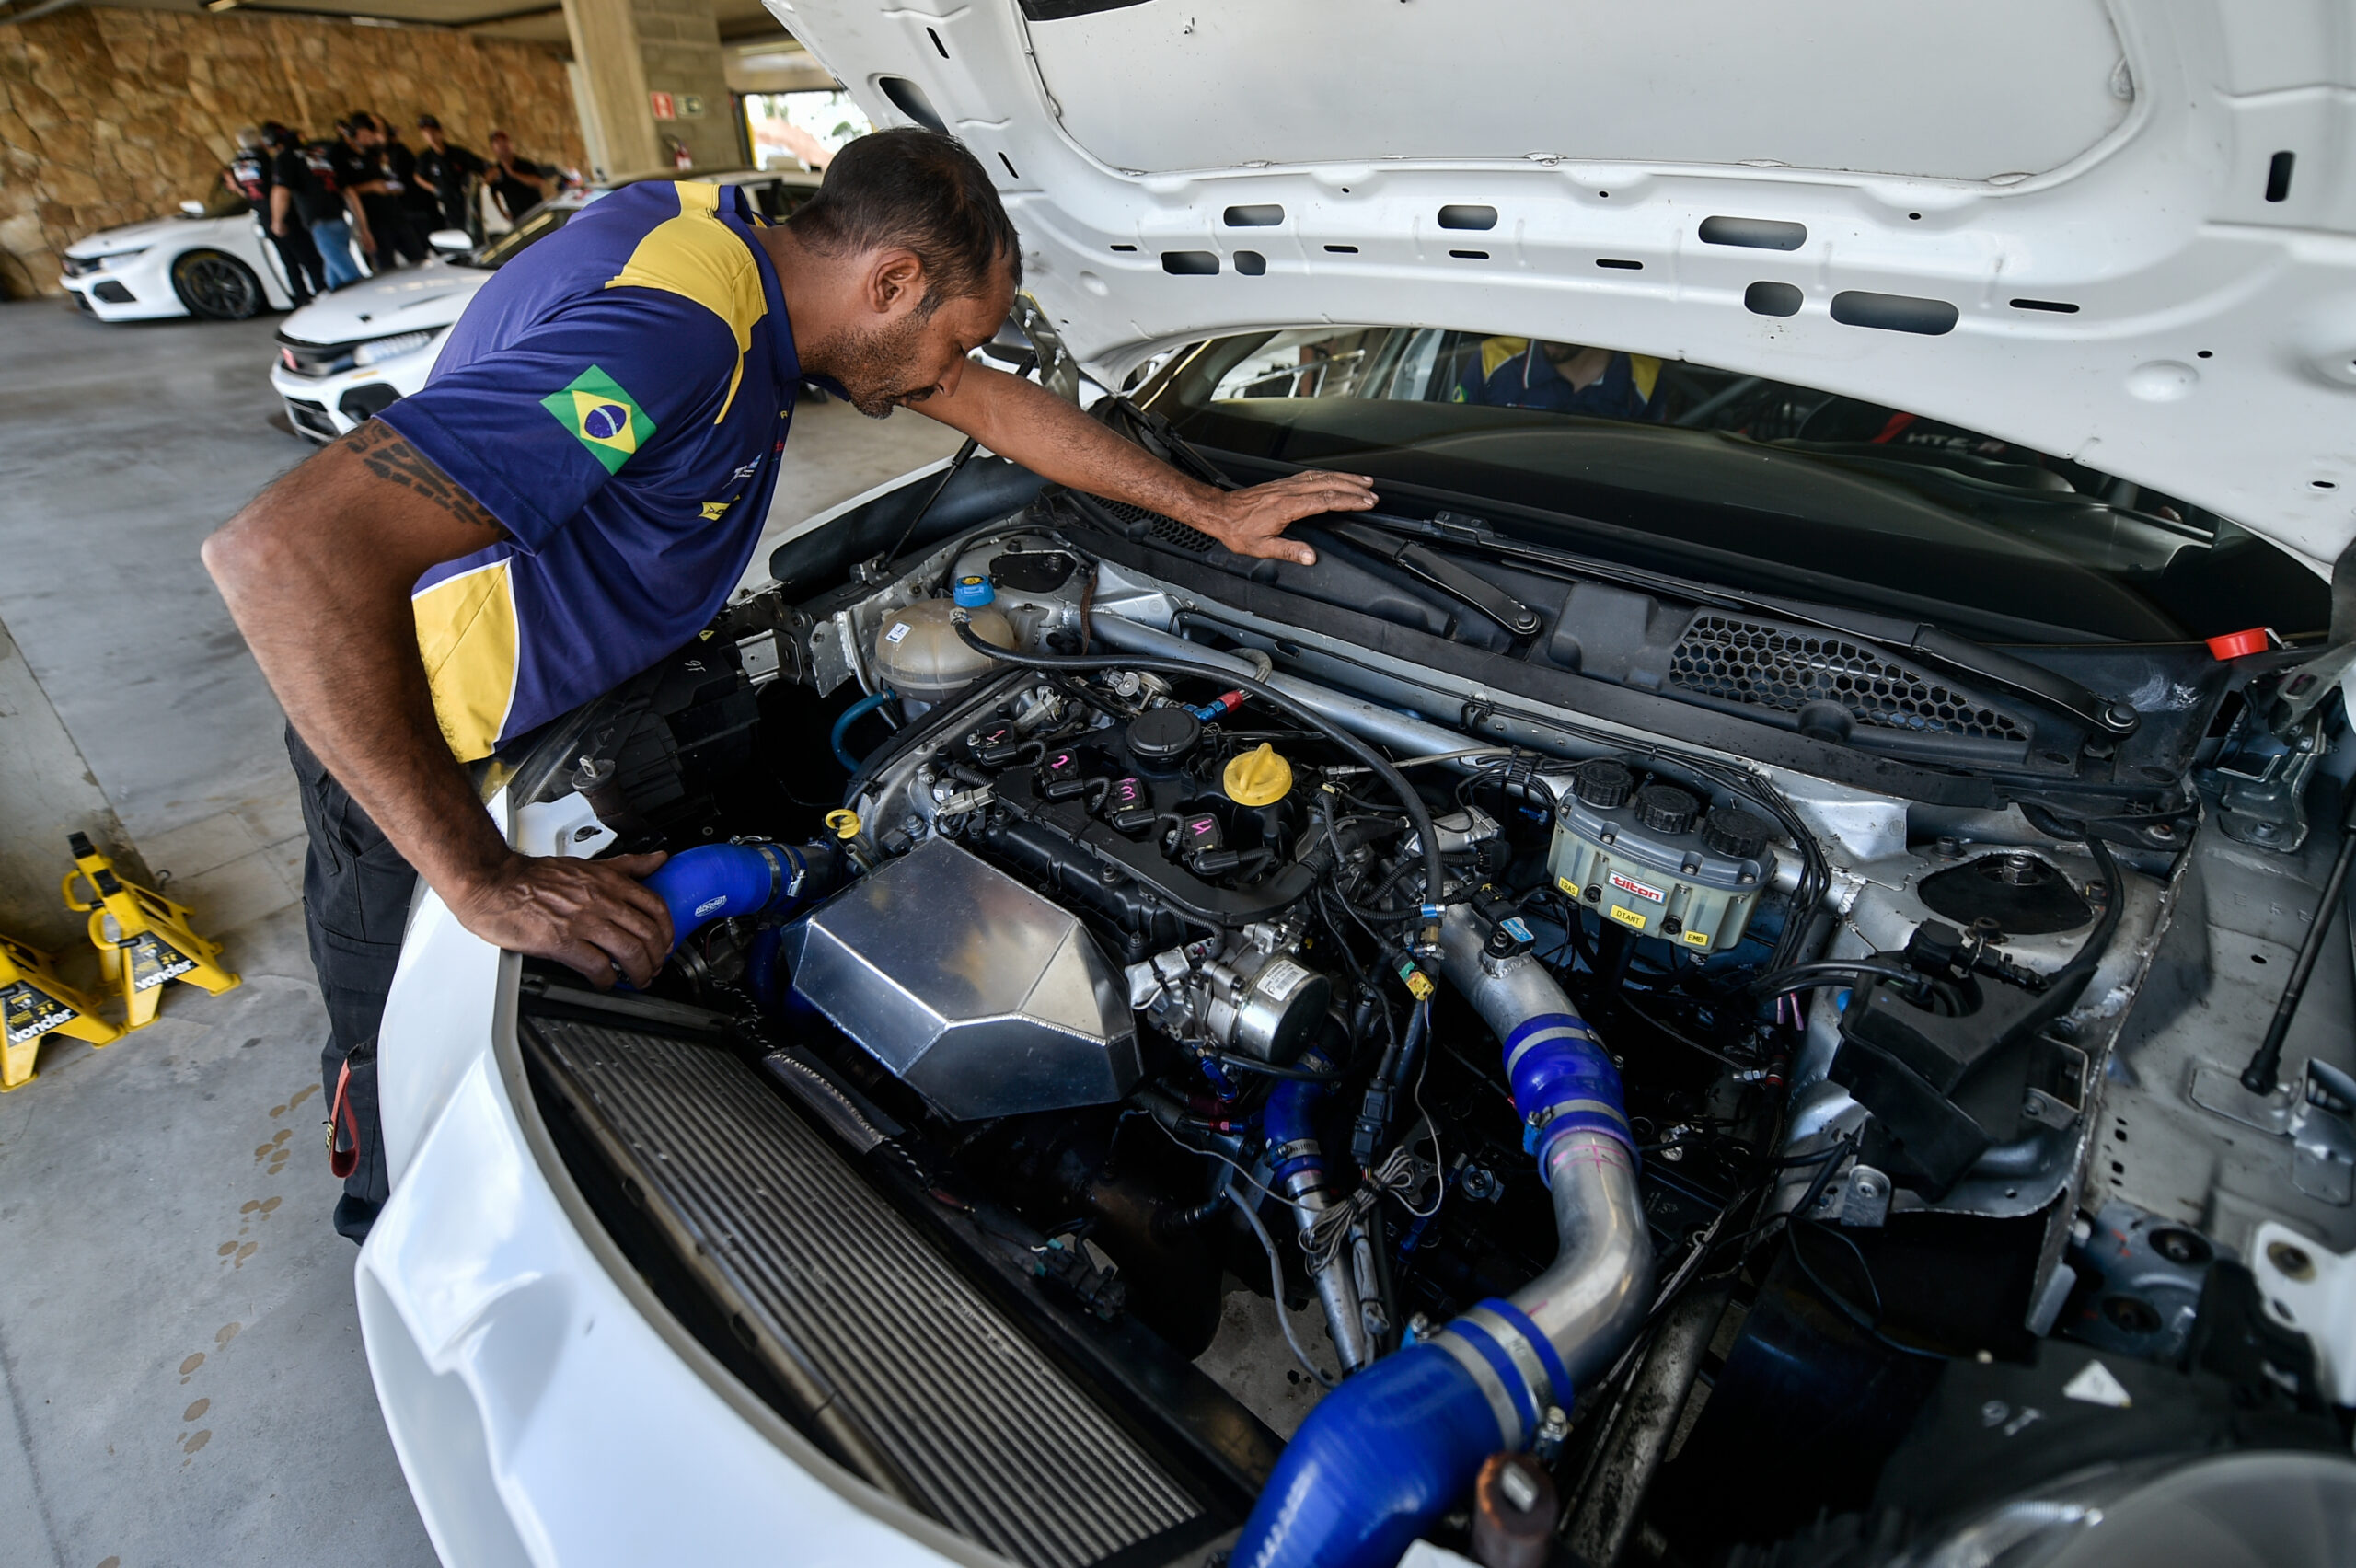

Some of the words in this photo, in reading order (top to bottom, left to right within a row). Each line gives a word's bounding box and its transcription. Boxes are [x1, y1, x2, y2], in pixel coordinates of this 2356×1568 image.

[1050, 755, 1069, 769] 2
[1120, 786, 1137, 801] 3
[1560, 881, 1576, 895] TRAS
[1612, 876, 1661, 901] tilton
[1616, 910, 1641, 926] DIANT
[1687, 934, 1703, 943] EMB
[134, 959, 191, 989] vonder
[8, 1009, 73, 1043] vonder
